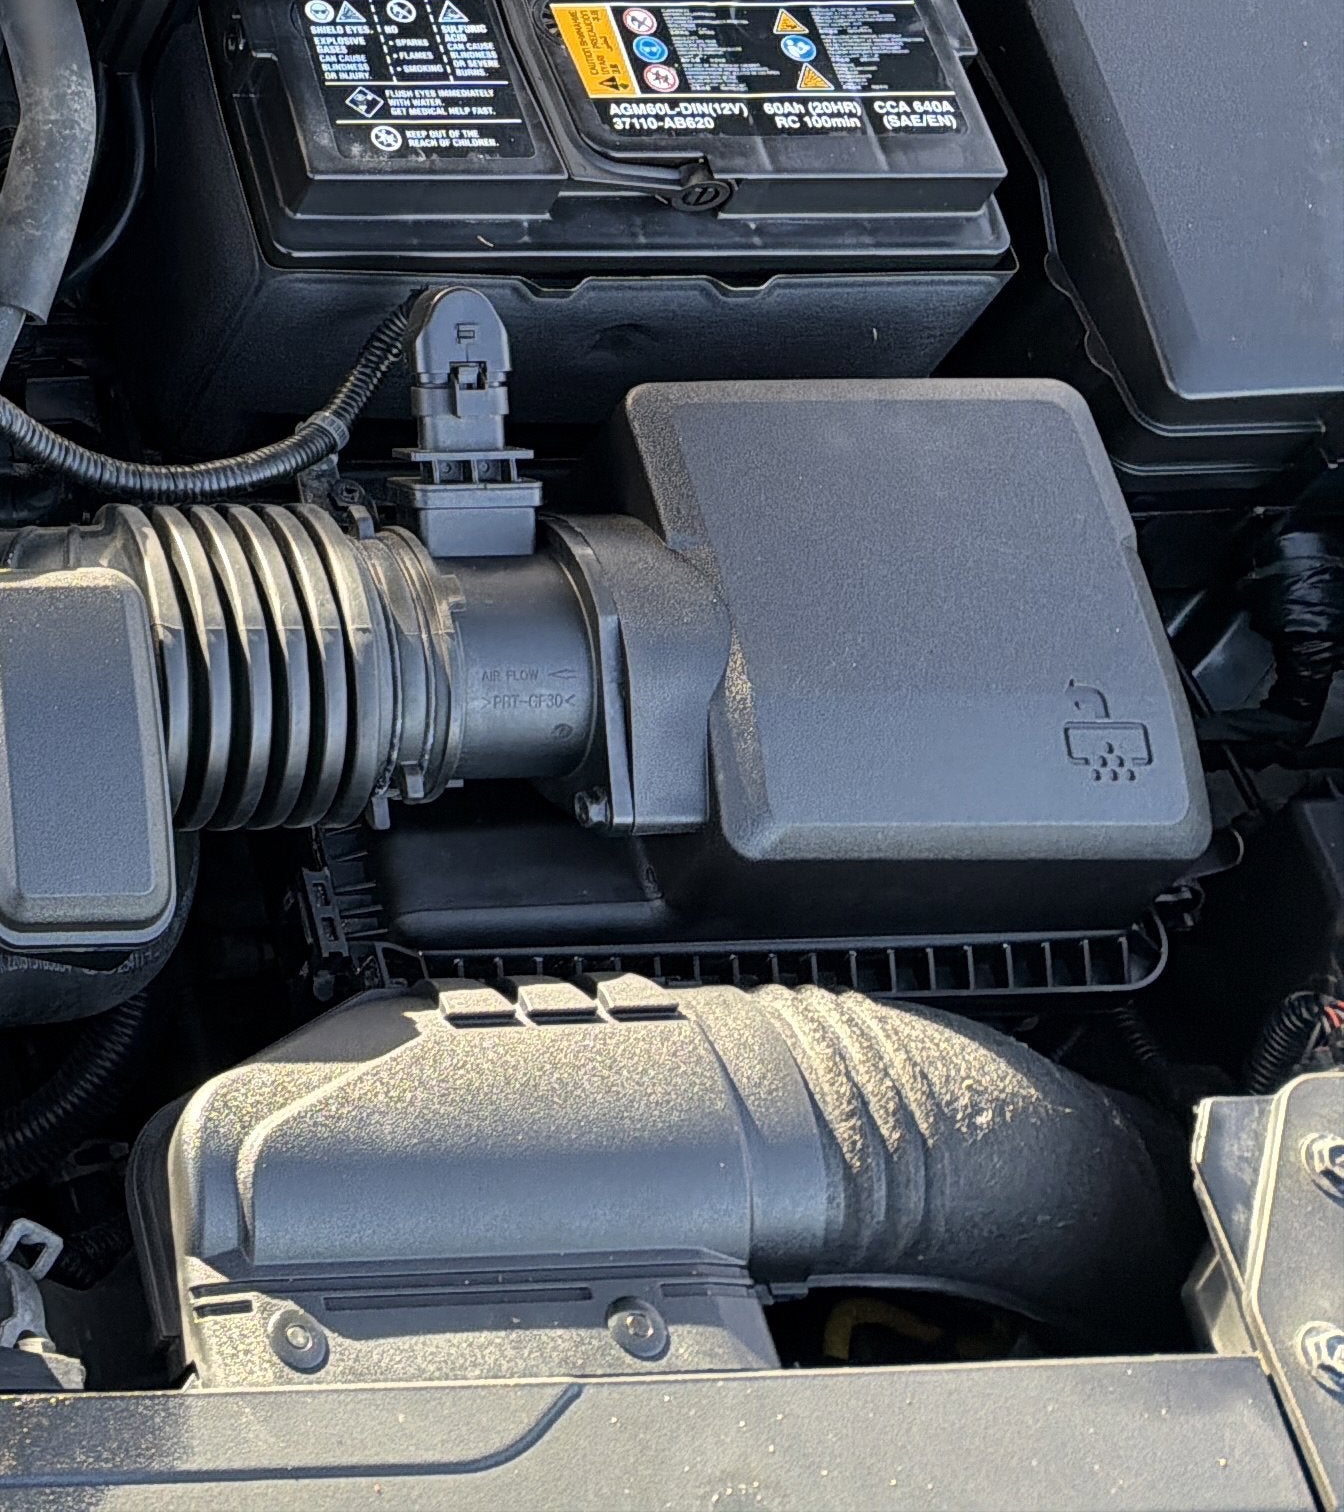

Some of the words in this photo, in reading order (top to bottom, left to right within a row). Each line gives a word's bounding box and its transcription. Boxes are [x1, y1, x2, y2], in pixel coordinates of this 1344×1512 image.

[311, 25, 344, 34] SHIELD
[345, 25, 374, 34] EYES.
[384, 25, 398, 34] NO
[441, 25, 488, 34] SULFURIC
[314, 37, 366, 46] EXPLOSIVE
[445, 33, 468, 42] ACID
[396, 38, 429, 47] SPARKS
[447, 42, 465, 50] CAN
[466, 41, 495, 50] CAUSE
[316, 45, 348, 54] GASES
[319, 54, 337, 63] CAN
[338, 54, 367, 62] CAUSE
[399, 51, 434, 60] FLAMES
[450, 51, 498, 59] BLINDNESS
[322, 63, 370, 72] BLINDNESS
[453, 59, 466, 68] OR
[468, 59, 500, 68] SEVERE
[403, 64, 443, 73] SMOKING
[325, 71, 337, 80] OR
[339, 71, 372, 80] INJURY.
[386, 90, 413, 98] FLUSH
[414, 90, 436, 98] EYES
[438, 89, 494, 98] IMMEDIATELY
[388, 98, 410, 106] WITH
[412, 98, 445, 107] WATER.
[391, 107, 408, 115] GET
[409, 107, 447, 115] MEDICAL
[449, 107, 471, 115] HELP
[472, 107, 496, 115] FAST.
[610, 102, 748, 117] AGM60L-DIN(12V)
[764, 101, 805, 114] 60Ah
[808, 101, 862, 115] (20HR)
[874, 101, 910, 114] CCA
[912, 101, 954, 113] 640A
[613, 117, 715, 129] 37110-AB620
[775, 116, 800, 128] RC
[804, 115, 861, 128] 100min
[883, 114, 957, 130] (SAE/EN)
[406, 130, 427, 139] KEEP
[429, 130, 447, 139] OUT
[449, 130, 460, 138] OF
[462, 130, 479, 138] THE
[408, 138, 438, 147] REACH
[440, 138, 451, 147] OF
[453, 138, 500, 147] CHILDREN.
[482, 670, 501, 681] AIR
[505, 669, 539, 681] FLOW
